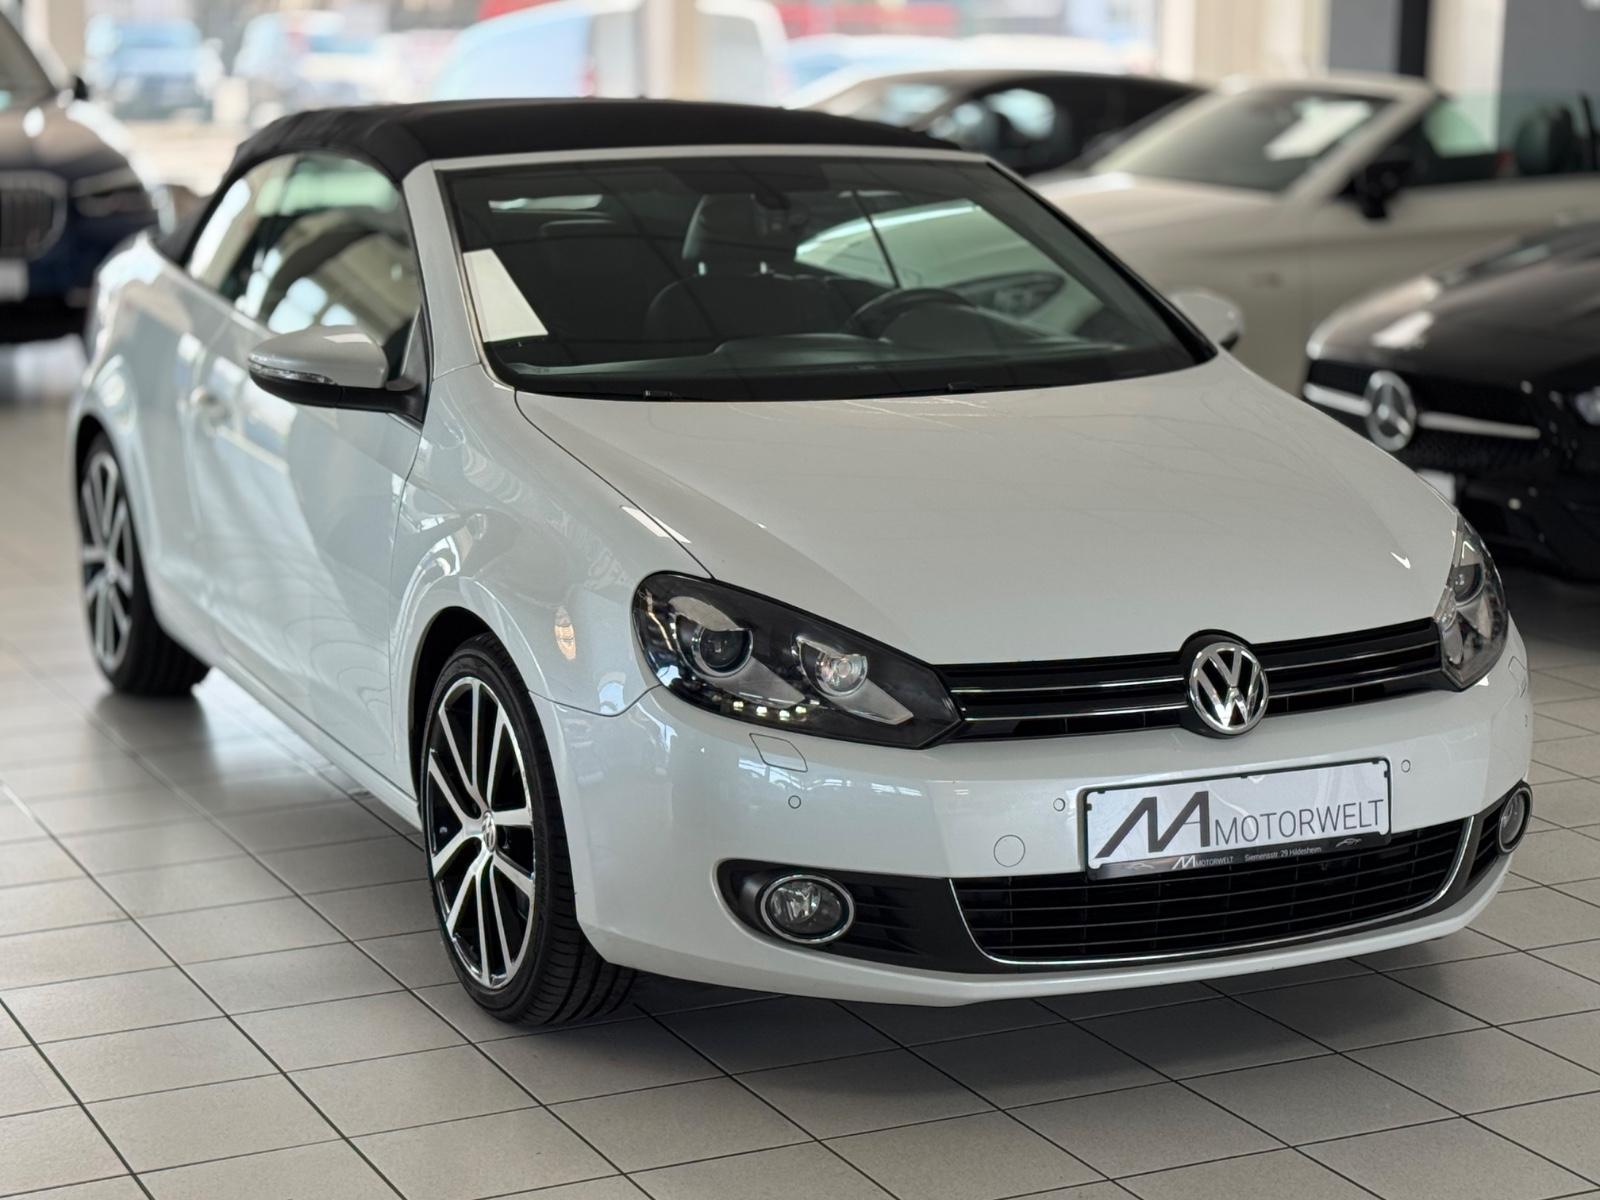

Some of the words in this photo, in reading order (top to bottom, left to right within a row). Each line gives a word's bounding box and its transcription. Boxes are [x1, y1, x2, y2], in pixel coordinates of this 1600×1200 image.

[1190, 642, 1269, 735] VW
[1214, 799, 1384, 846] MOTORWELT
[1196, 856, 1234, 866] MOTORWELT
